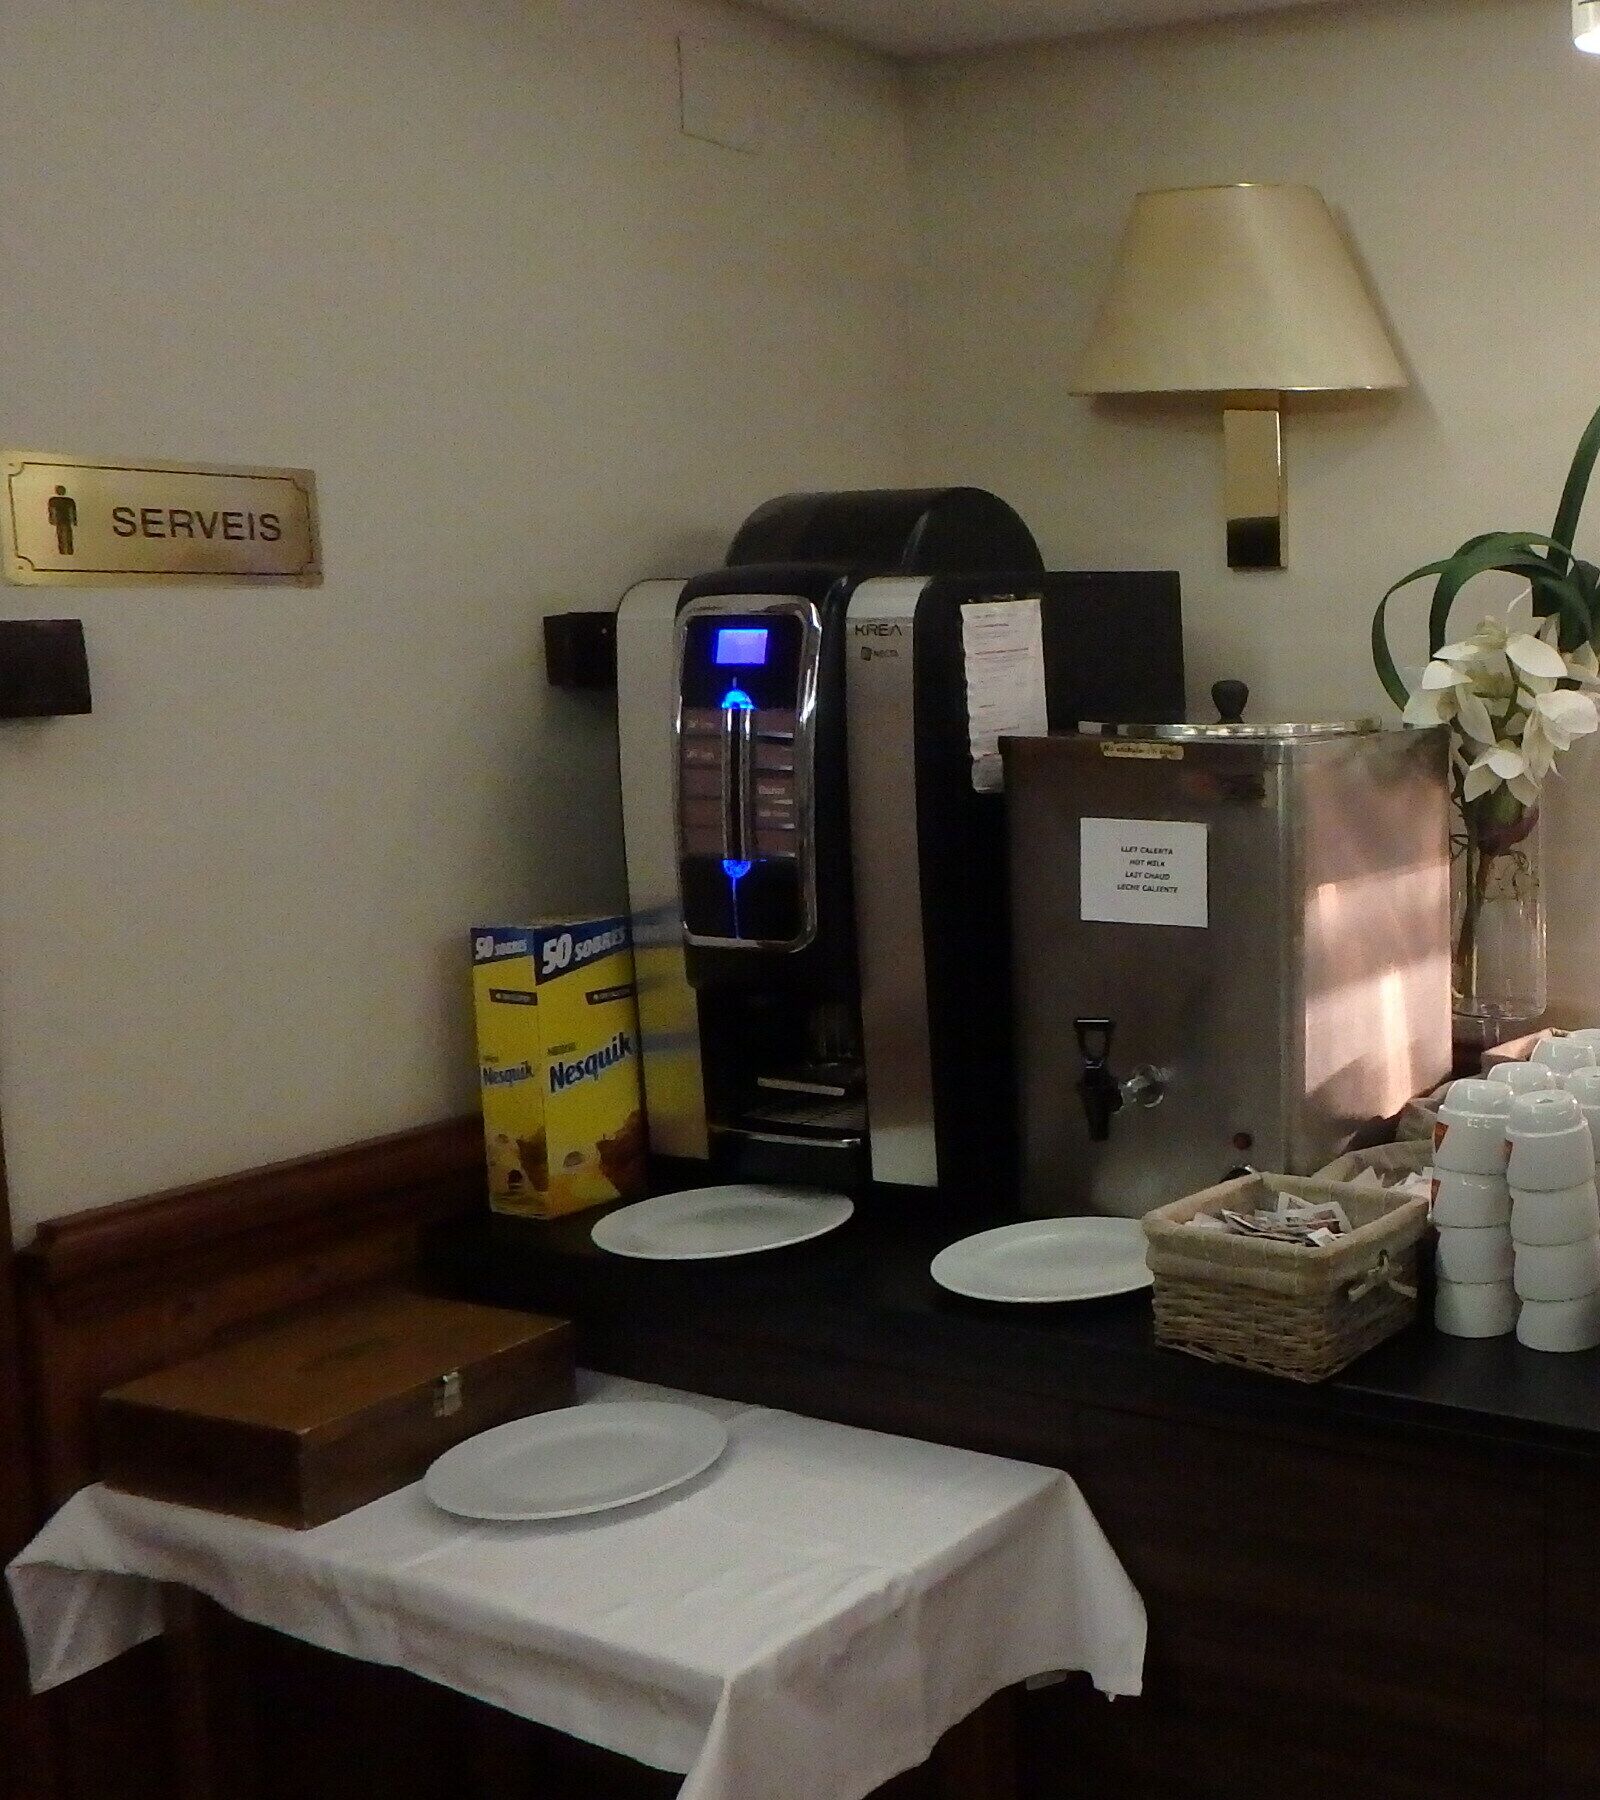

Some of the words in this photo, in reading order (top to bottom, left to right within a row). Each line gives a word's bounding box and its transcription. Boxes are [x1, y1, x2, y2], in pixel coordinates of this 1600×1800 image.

[112, 506, 282, 542] SERVEIS
[854, 623, 903, 637] KREA
[1117, 883, 1141, 891] LECHE
[1142, 884, 1179, 893] CALIENTE
[1144, 872, 1171, 881] CHAUD
[475, 935, 494, 960] 50
[541, 933, 573, 975] 50
[482, 1060, 534, 1087] Nesquik
[549, 1031, 634, 1094] Nesquik
